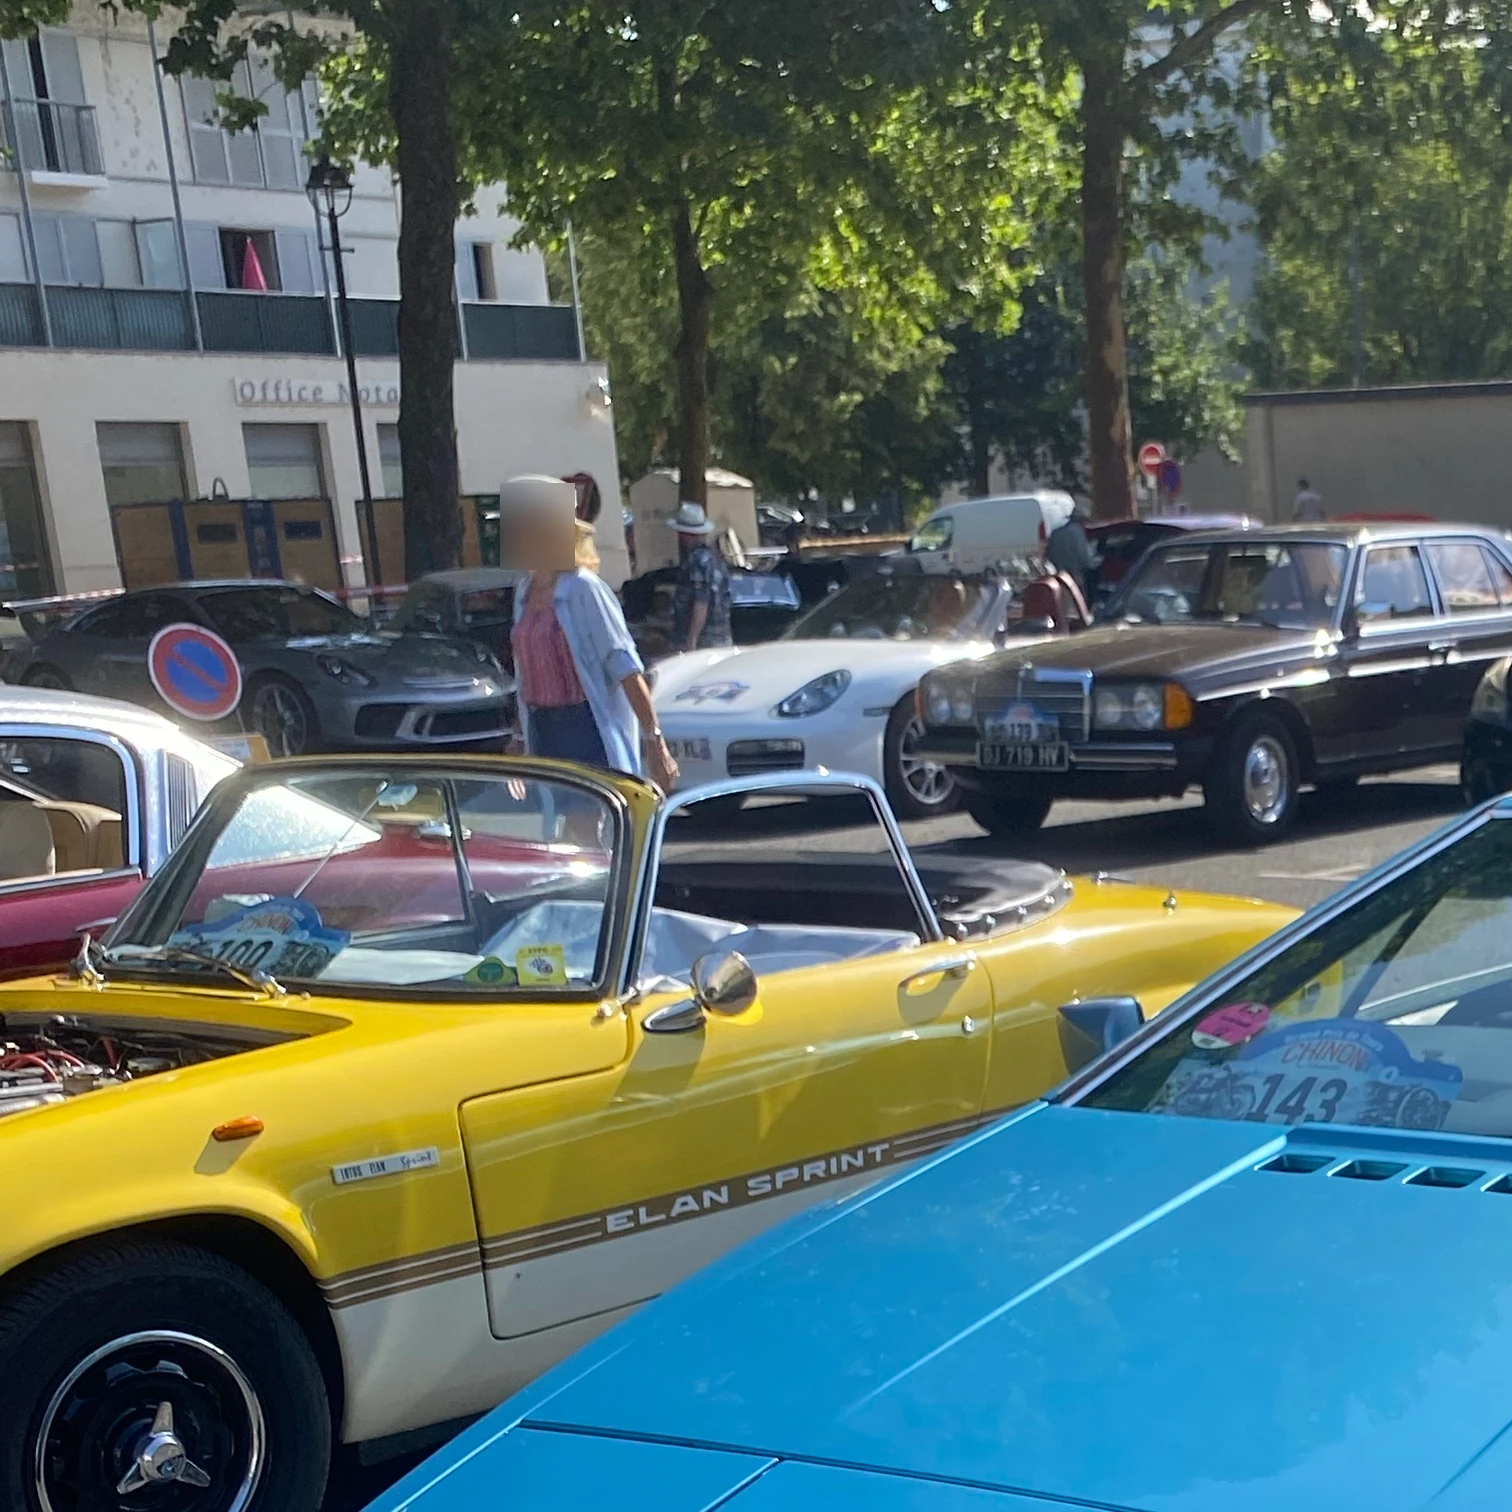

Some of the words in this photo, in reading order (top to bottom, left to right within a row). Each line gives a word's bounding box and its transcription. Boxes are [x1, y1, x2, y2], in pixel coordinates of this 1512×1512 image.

[240, 379, 323, 402] Office
[216, 940, 274, 969] 100
[1281, 1040, 1367, 1073] CHINON
[1246, 1073, 1348, 1125] 143
[340, 1165, 363, 1180] LOTUS
[368, 1161, 386, 1174] ELAN
[605, 1186, 729, 1234] ELAN
[747, 1143, 889, 1197] SPRINT
